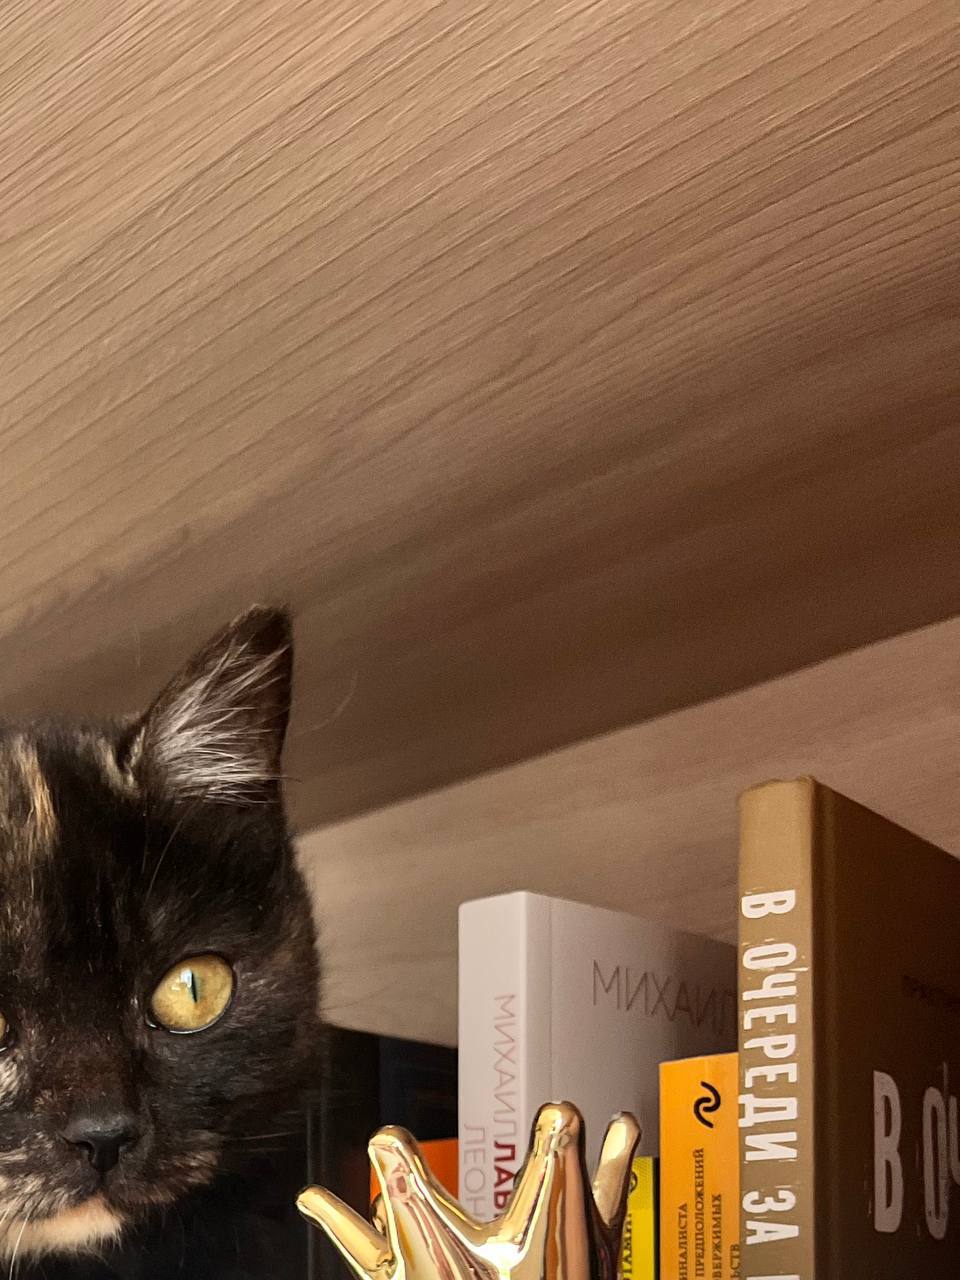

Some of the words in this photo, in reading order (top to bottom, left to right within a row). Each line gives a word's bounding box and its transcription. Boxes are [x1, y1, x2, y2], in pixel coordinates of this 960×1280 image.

[742, 889, 797, 919] В
[493, 994, 517, 1138] МИХАИЛ
[738, 943, 799, 1162] ОЧЕРЕДИ
[493, 1140, 517, 1217] ЛАБ
[693, 1148, 705, 1278] ПРЕДПОЛОЖЕНИЙ
[873, 1069, 904, 1233] В
[742, 1190, 800, 1246] ЗА
